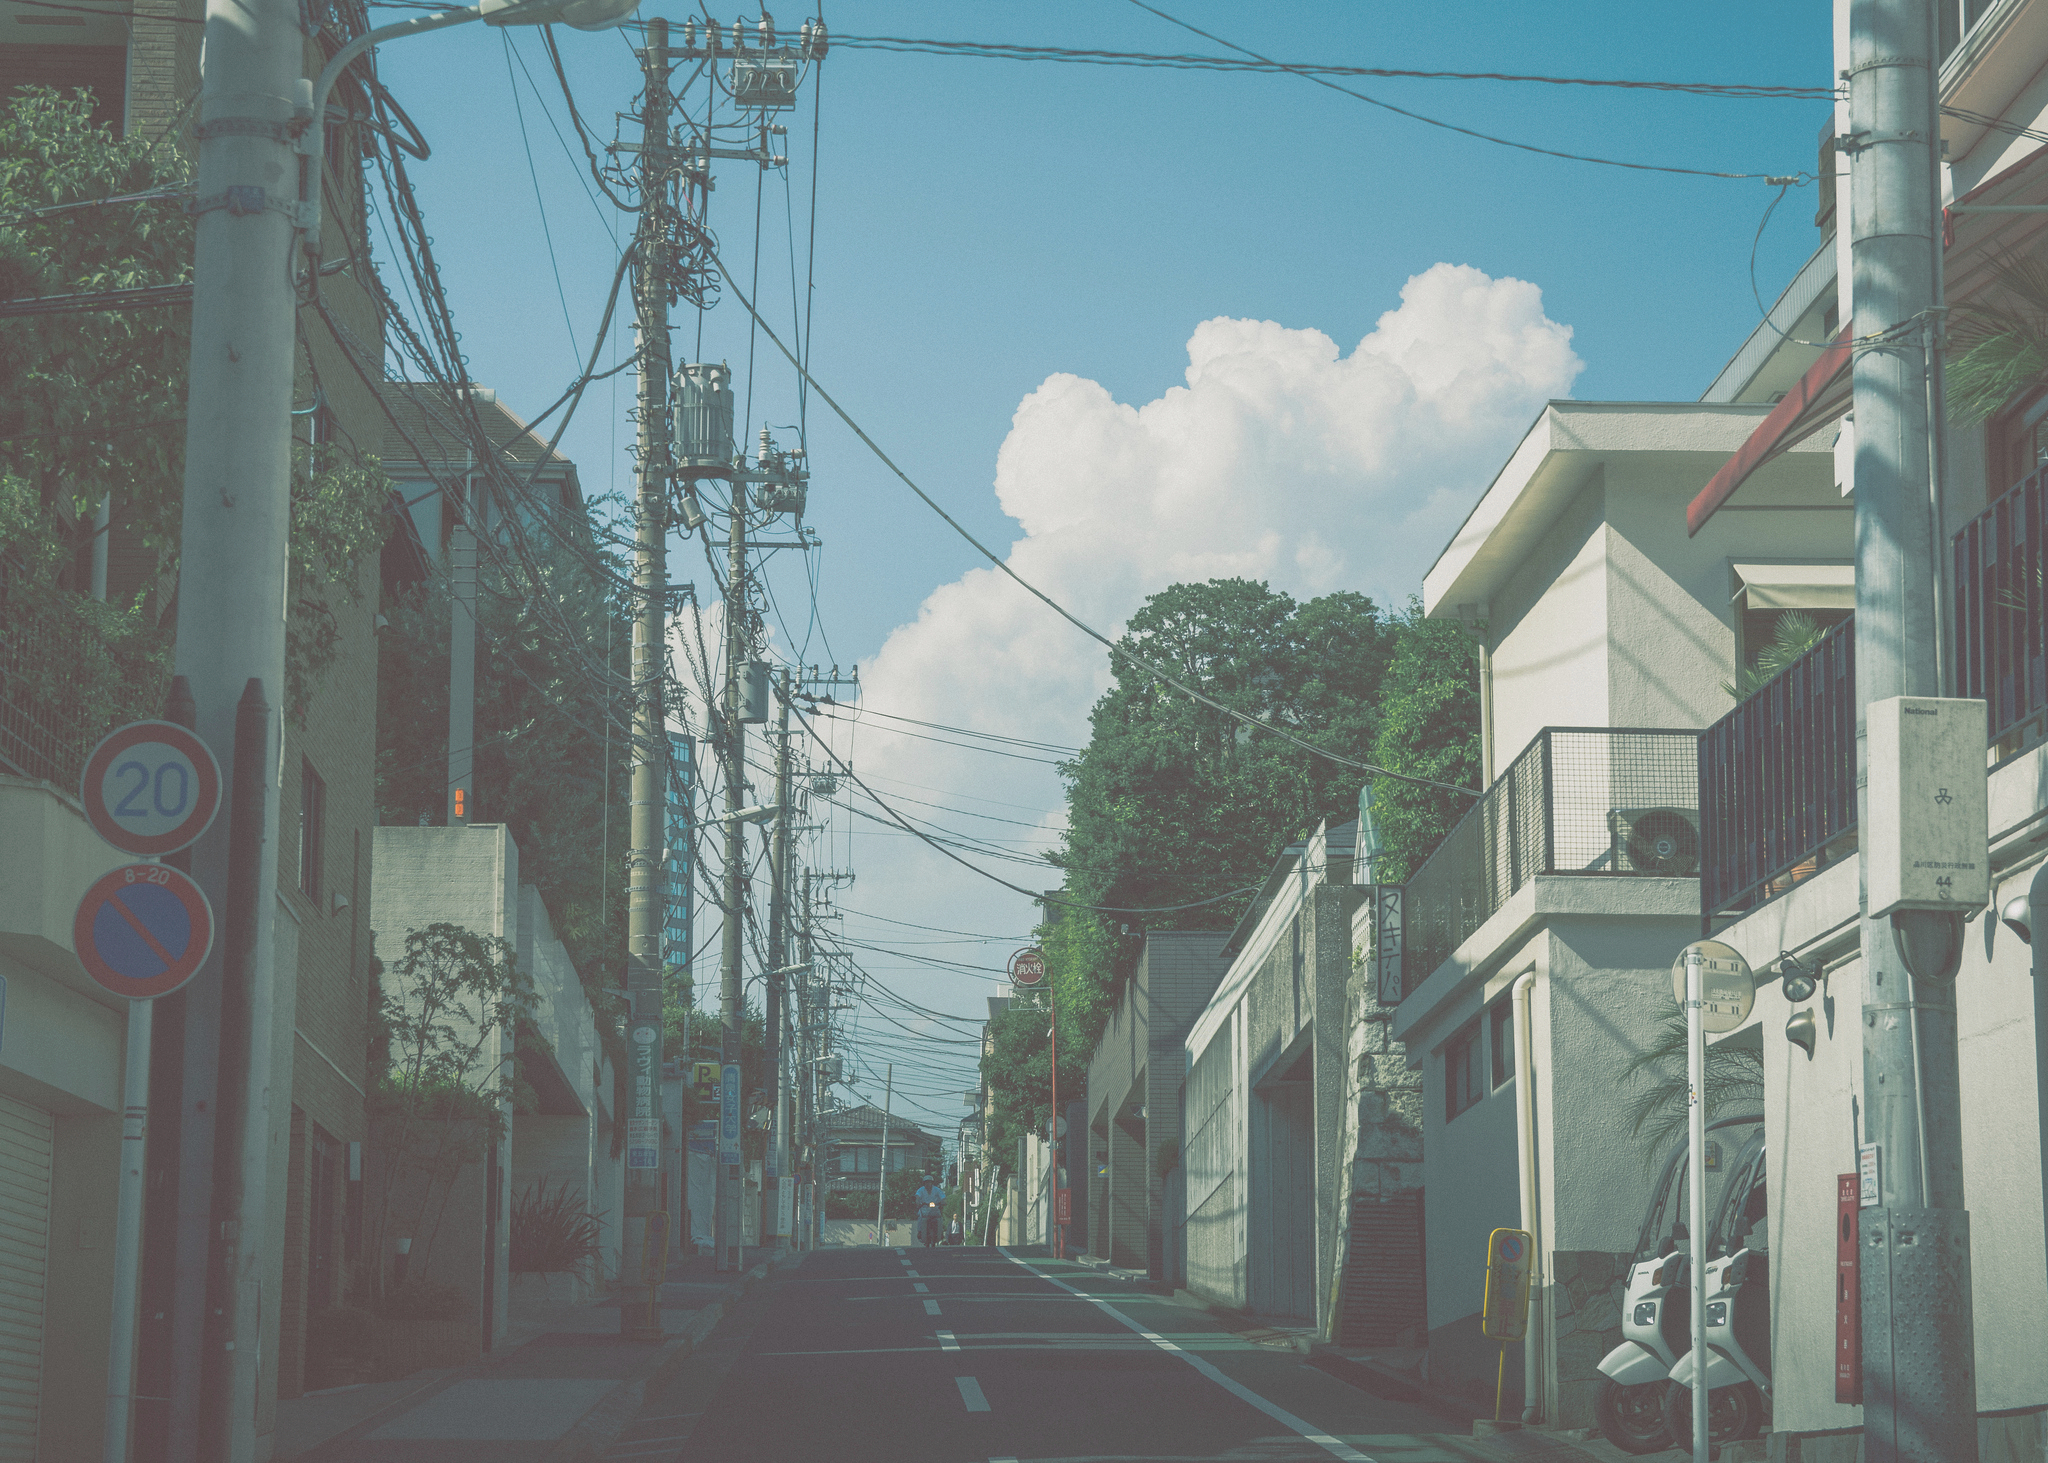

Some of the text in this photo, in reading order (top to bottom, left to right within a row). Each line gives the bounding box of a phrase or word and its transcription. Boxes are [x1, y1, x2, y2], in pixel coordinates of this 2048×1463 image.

[1904, 707, 1938, 716] National
[114, 760, 189, 818] 20
[124, 866, 170, 886] 8-20
[1935, 875, 1953, 888] 44
[1381, 892, 1401, 996] ヌキテパ
[1016, 962, 1043, 975] 消火栓
[636, 1045, 652, 1117] ラヴィ動物病院
[698, 1065, 711, 1083] P
